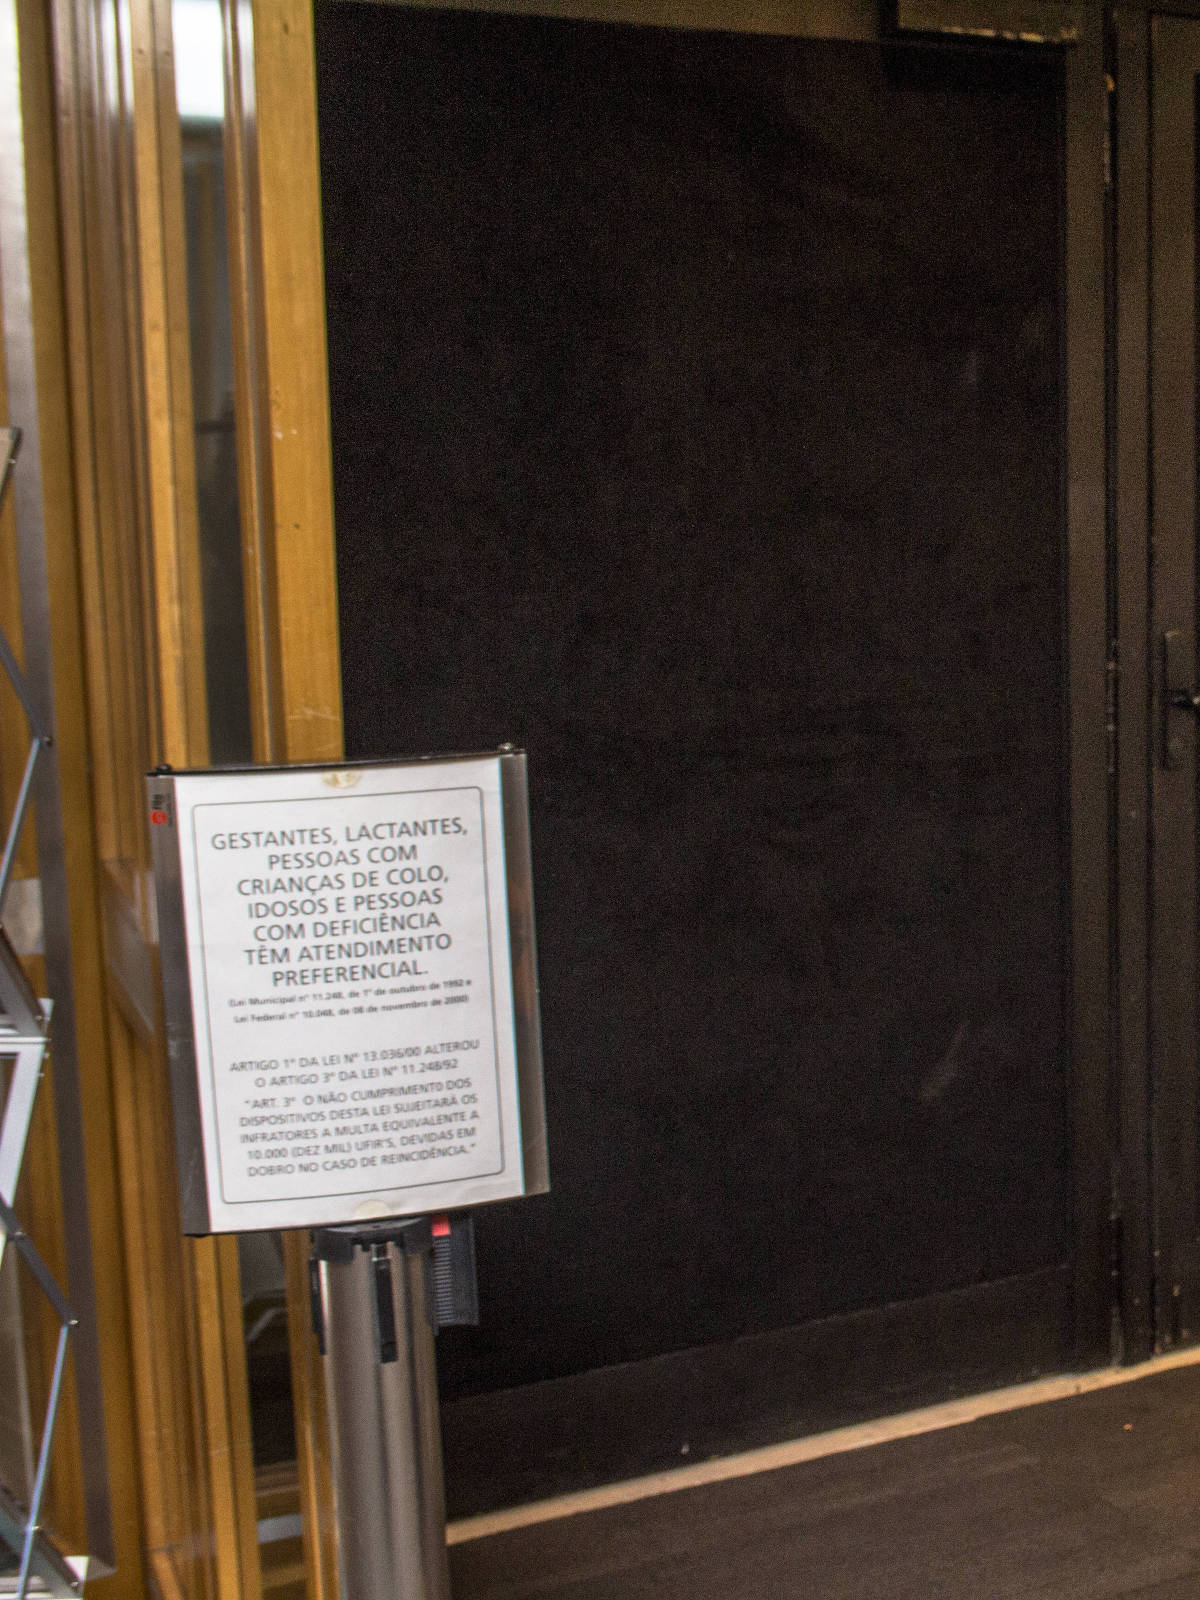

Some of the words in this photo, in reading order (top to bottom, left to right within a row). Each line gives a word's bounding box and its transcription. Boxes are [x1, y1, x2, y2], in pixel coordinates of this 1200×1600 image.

[211, 828, 338, 850] GESTANTES,
[346, 817, 468, 842] LACTANTES,
[268, 849, 361, 870] PESSOAS
[367, 844, 418, 863] COM
[237, 873, 345, 897] CRIANÇAS
[352, 871, 379, 888] DE
[386, 864, 449, 886] COLO,
[248, 898, 328, 918] IDOSOS
[335, 896, 346, 912] E
[354, 888, 443, 912] PESSOAS
[254, 923, 306, 942] COM
[312, 912, 441, 938] DEFICIÊNCIA
[244, 945, 290, 966] TÊM
[298, 933, 452, 963] ATENDIMENTO
[272, 960, 429, 987] PREFERENCIAL.
[248, 995, 296, 1006] Municipal
[390, 984, 426, 994] outubro
[250, 1012, 286, 1022] Federal
[382, 1000, 428, 1010] novembro
[230, 1060, 278, 1072] ARTIGO
[299, 1058, 318, 1068] DA
[323, 1054, 340, 1066] LEI
[364, 1046, 422, 1062] 13.036/00
[424, 1040, 480, 1055] ALTEROU
[270, 1073, 319, 1086] ARTIGO
[338, 1070, 358, 1081] DA
[362, 1068, 379, 1078] LEI
[318, 1090, 347, 1104] NÃO
[351, 1082, 444, 1102] CUMPRIMENTO
[446, 1078, 472, 1090] DOS
[240, 1112, 326, 1128] DISPOSITIVOS
[329, 1108, 369, 1120] DESTA
[372, 1104, 390, 1116] LEI
[461, 1093, 478, 1104] OS
[240, 1128, 318, 1144] INFRATORES
[334, 1123, 379, 1137] MULTA
[383, 1113, 466, 1131] EQUIVALENTE
[248, 1148, 288, 1160] 10.000
[400, 1130, 454, 1147] DEVIDAS
[456, 1127, 476, 1138] EM
[248, 1164, 295, 1176] DOBRO
[298, 1162, 319, 1172] NO
[322, 1158, 357, 1171] CASO
[360, 1156, 376, 1167] DE
